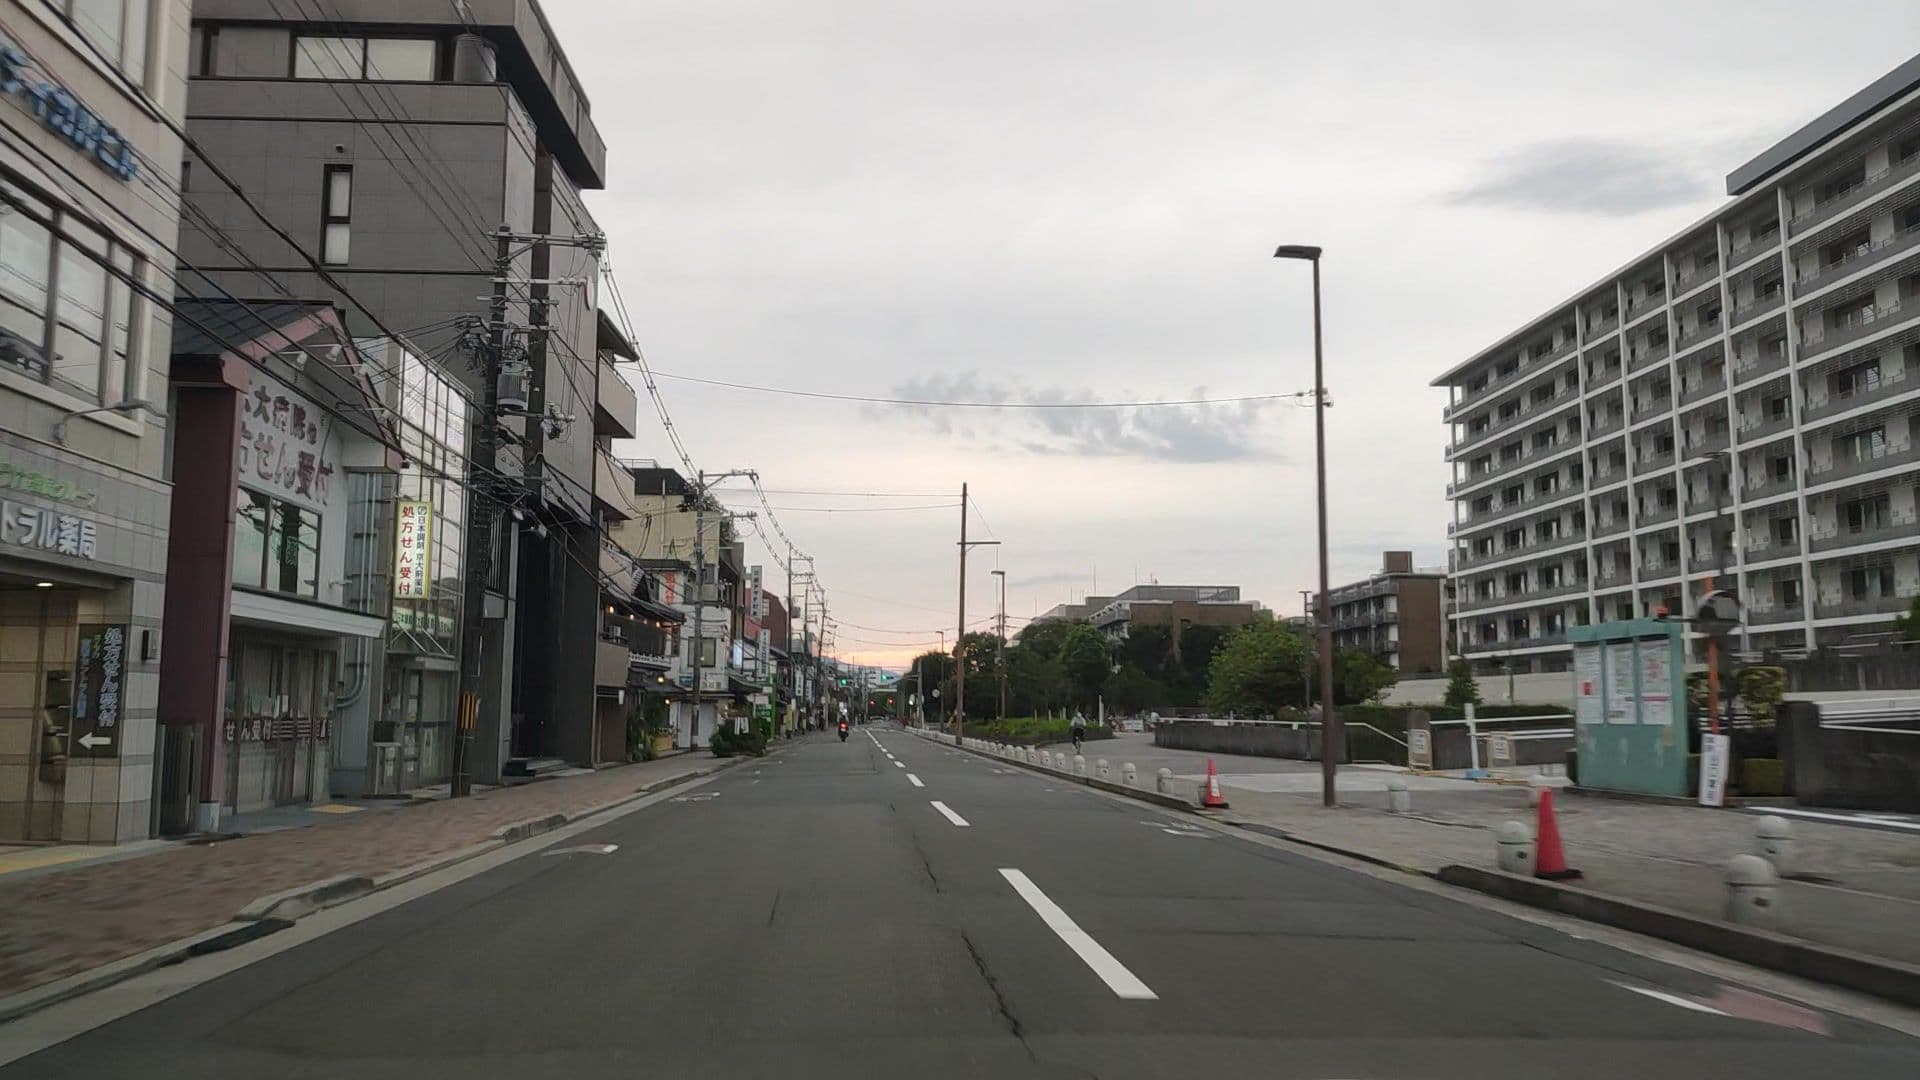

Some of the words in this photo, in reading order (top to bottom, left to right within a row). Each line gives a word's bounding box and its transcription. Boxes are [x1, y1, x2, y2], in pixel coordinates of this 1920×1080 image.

[399, 506, 414, 595] 処方せん受付
